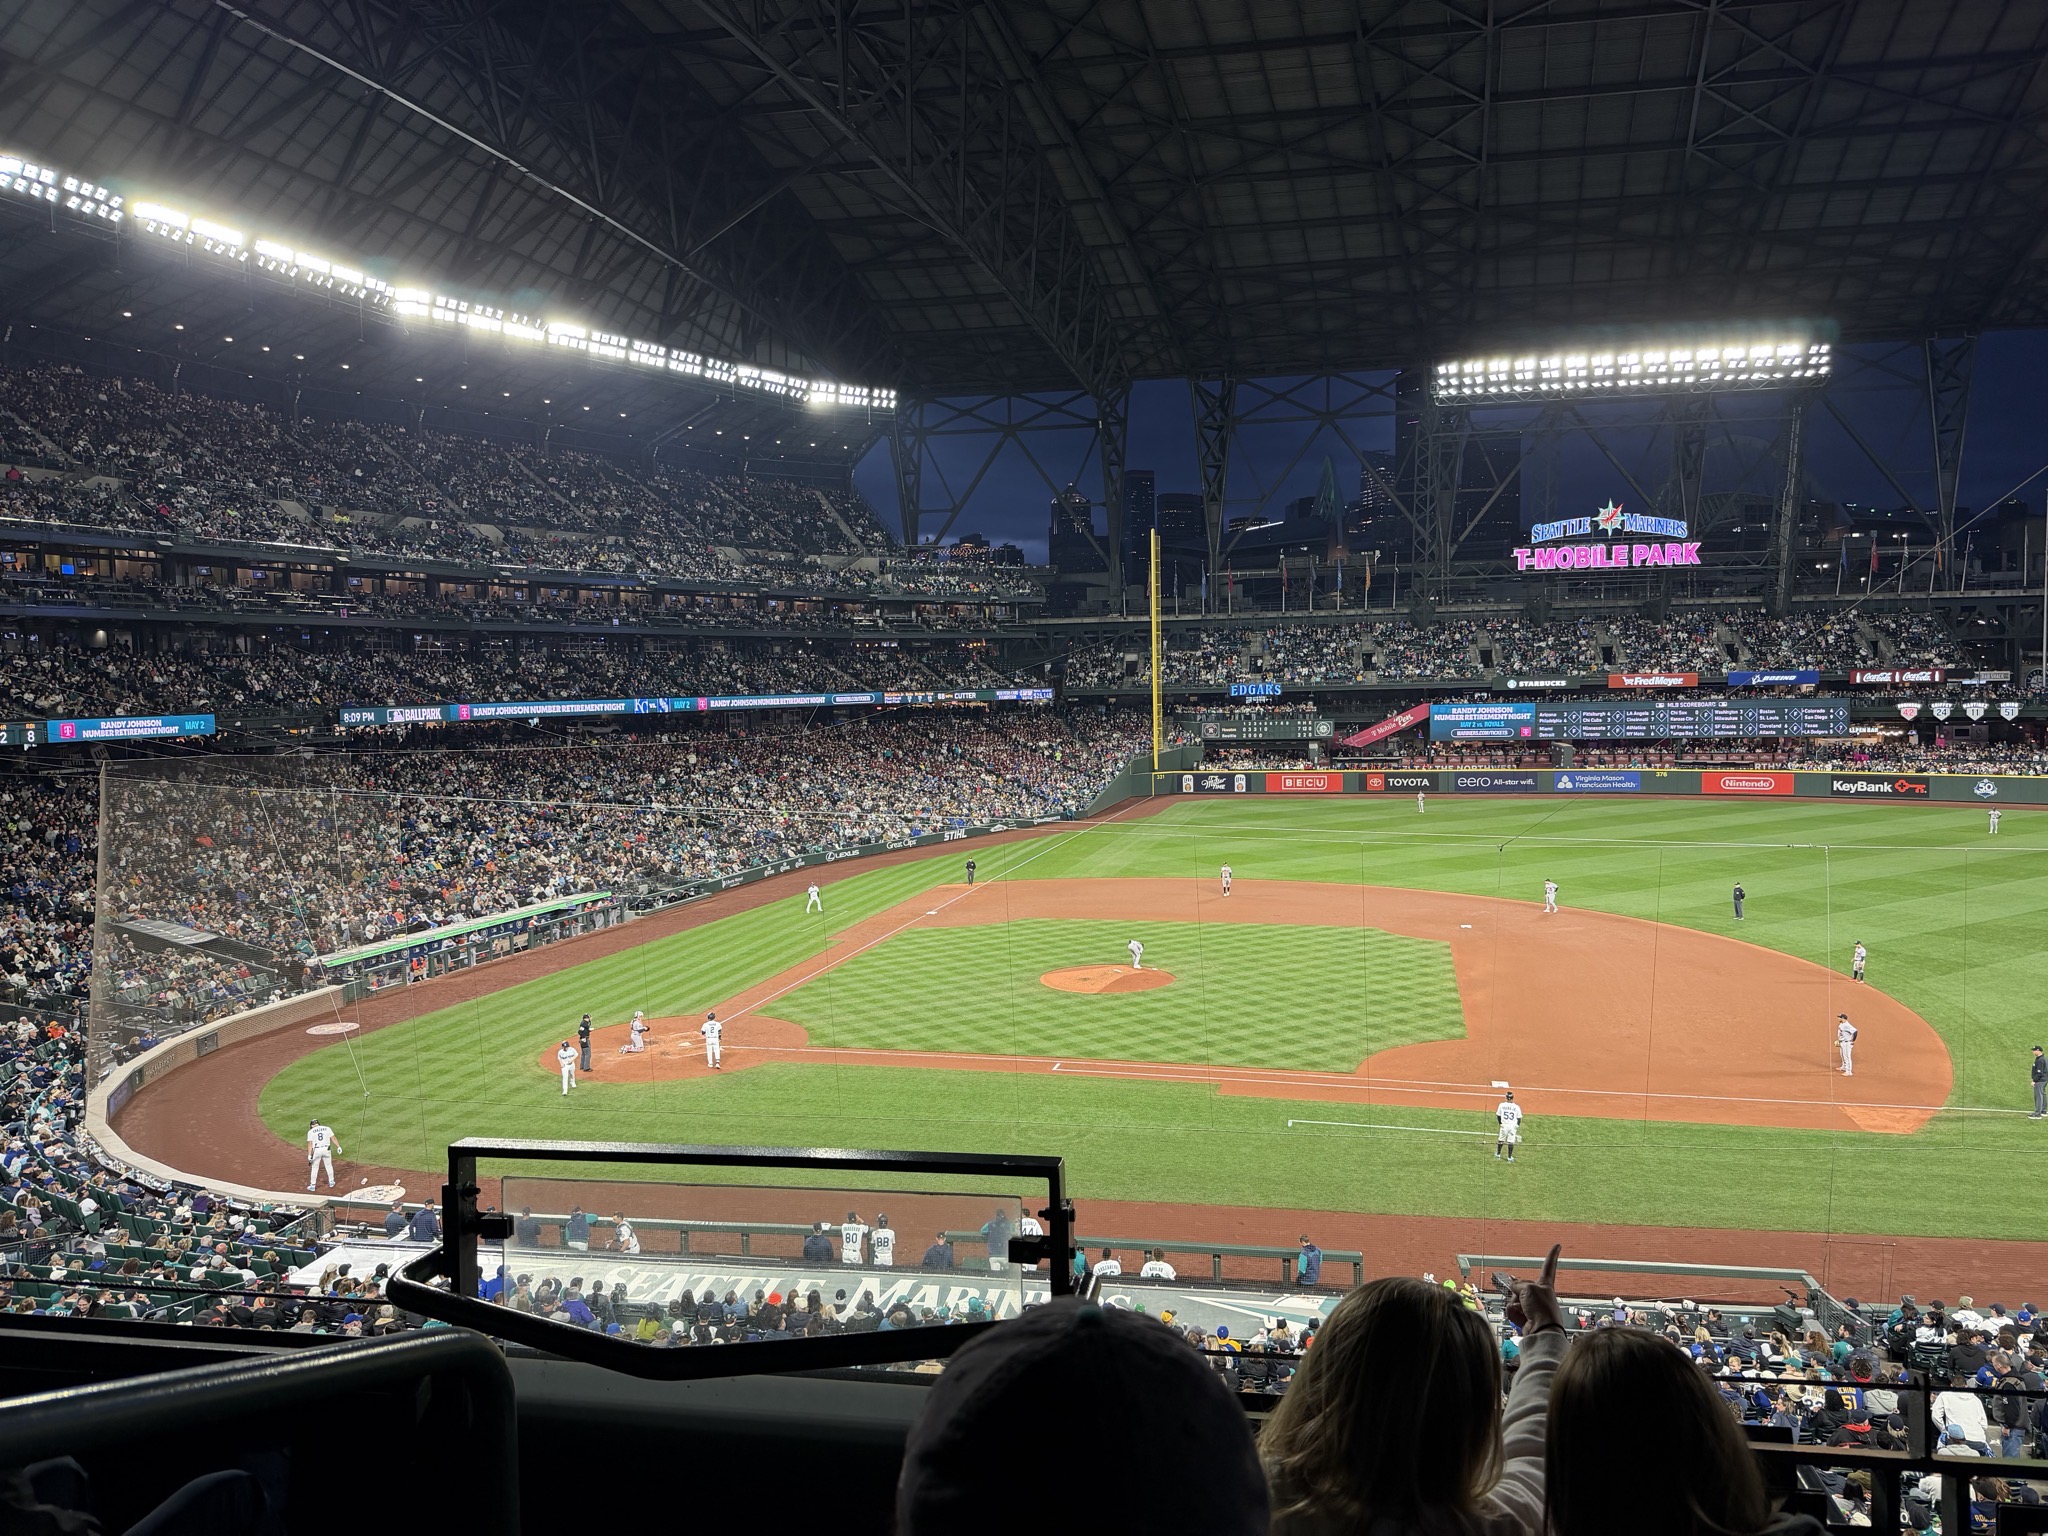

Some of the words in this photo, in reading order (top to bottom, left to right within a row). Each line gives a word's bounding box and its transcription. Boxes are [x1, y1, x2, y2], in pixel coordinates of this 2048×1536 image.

[1531, 516, 1591, 544] SEATTLE
[1623, 513, 1688, 539] MARINERS
[1514, 545, 1629, 571] T-MOBILE
[1633, 542, 1702, 566] PARK
[1863, 672, 1892, 682] Coca-Cola
[1902, 672, 1931, 682] Coca-Cola
[1231, 684, 1281, 696] EDGAR'S
[730, 699, 757, 707] JOHNSON
[405, 708, 442, 721] BALLPARK
[473, 706, 495, 716] RANDY
[495, 706, 530, 716] JOHNSON
[530, 705, 561, 714] NUMBER
[561, 704, 604, 713] RETIREMENT
[604, 703, 625, 712] NIGHT
[344, 712, 360, 722] 8:09
[362, 712, 374, 721] PM
[100, 721, 127, 729] RANDY
[127, 719, 162, 728] JOHNSON
[185, 721, 199, 730] MAY
[200, 720, 205, 729] 2
[1377, 722, 1397, 734] Mobile
[28, 731, 35, 742] 8
[82, 729, 114, 738] NUMBER
[114, 727, 157, 737] RETIREMENT
[157, 726, 180, 735] NIGHT
[1285, 777, 1324, 787] BECU
[1388, 778, 1430, 787] TOYOTA
[1458, 777, 1491, 787] eero
[1724, 778, 1770, 788] Nintendo
[1833, 780, 1892, 793] KeyBank
[1978, 781, 1992, 791] 50
[944, 830, 967, 841] STIHL
[887, 841, 902, 849] Great
[903, 839, 917, 847] Clips
[836, 850, 860, 858] LEXUS
[1503, 1112, 1515, 1120] 53
[318, 1133, 323, 1141] 8
[846, 1233, 857, 1243] 80
[605, 1266, 827, 1305] SEATTLE
[1842, 1395, 1857, 1410] 51
